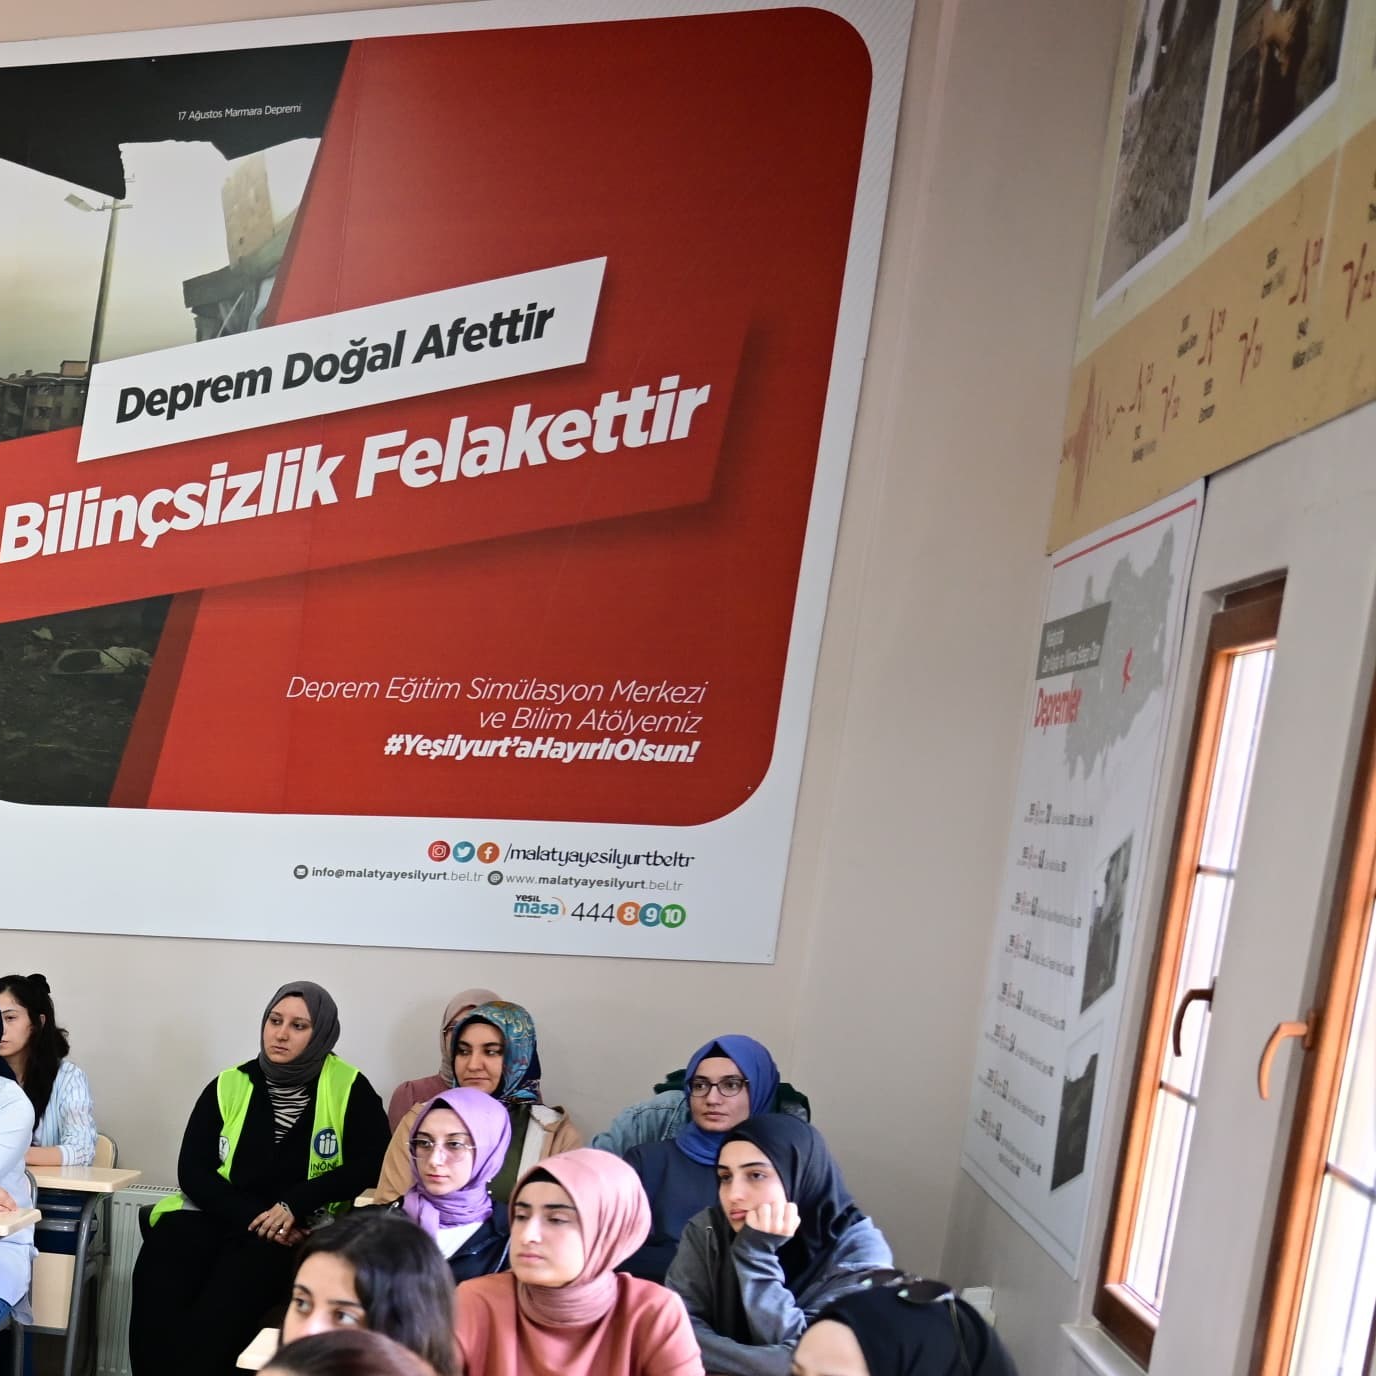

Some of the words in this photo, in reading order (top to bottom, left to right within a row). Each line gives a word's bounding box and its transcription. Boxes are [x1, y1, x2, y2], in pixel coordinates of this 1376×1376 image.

[178, 111, 186, 120] 17
[188, 110, 222, 122] Ağustos
[224, 107, 262, 118] Marmara
[264, 102, 302, 116] Depremi
[116, 366, 273, 424] Deprem
[281, 329, 405, 391] Doğal
[412, 301, 555, 364] Afettir
[355, 374, 711, 499] Felakettir
[285, 676, 379, 703] Deprem
[385, 676, 460, 703] Eğitim
[466, 676, 604, 704] Simülasyon
[610, 679, 709, 705] Merkezi
[479, 711, 506, 730] ve
[511, 707, 571, 731] Bilim
[577, 708, 704, 735] Atölyemiz
[311, 866, 484, 883] info@malatyayesilyurt.bel.tr
[505, 873, 684, 892] www.malatyayesilyurt.bel.tr
[513, 902, 559, 915] masa
[570, 901, 616, 923] 444
[664, 908, 682, 924] 10
